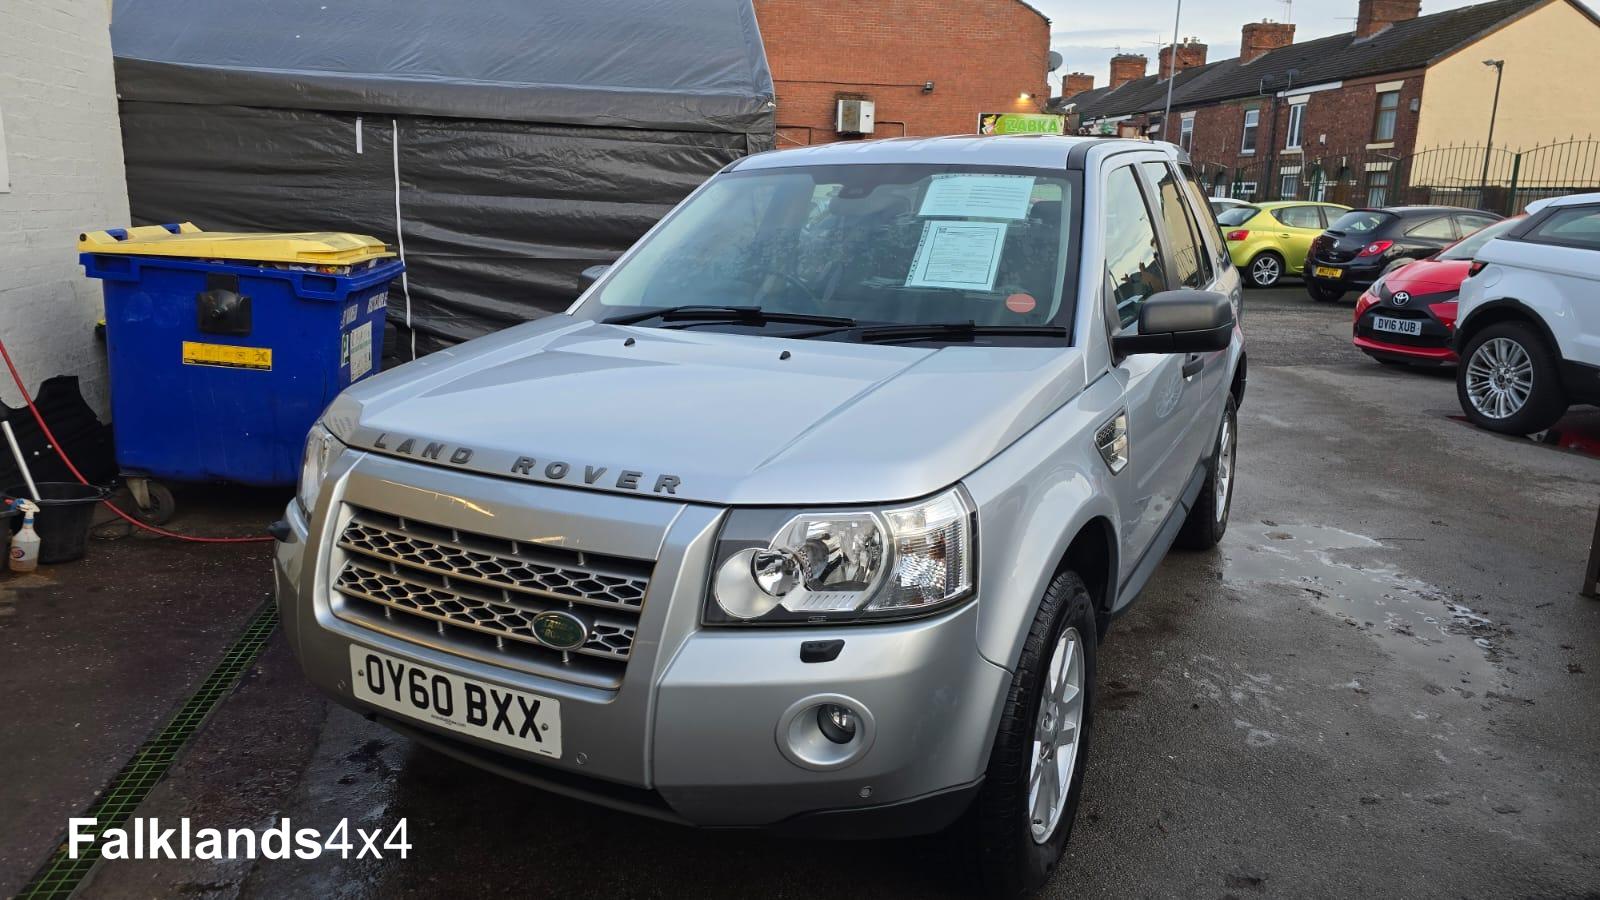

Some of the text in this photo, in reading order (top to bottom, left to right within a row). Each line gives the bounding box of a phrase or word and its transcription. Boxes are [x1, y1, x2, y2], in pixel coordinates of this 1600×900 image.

[1378, 319, 1416, 332] DY16 XUB
[373, 433, 681, 494] LAND ROVER
[365, 653, 543, 742] OY60 BXX
